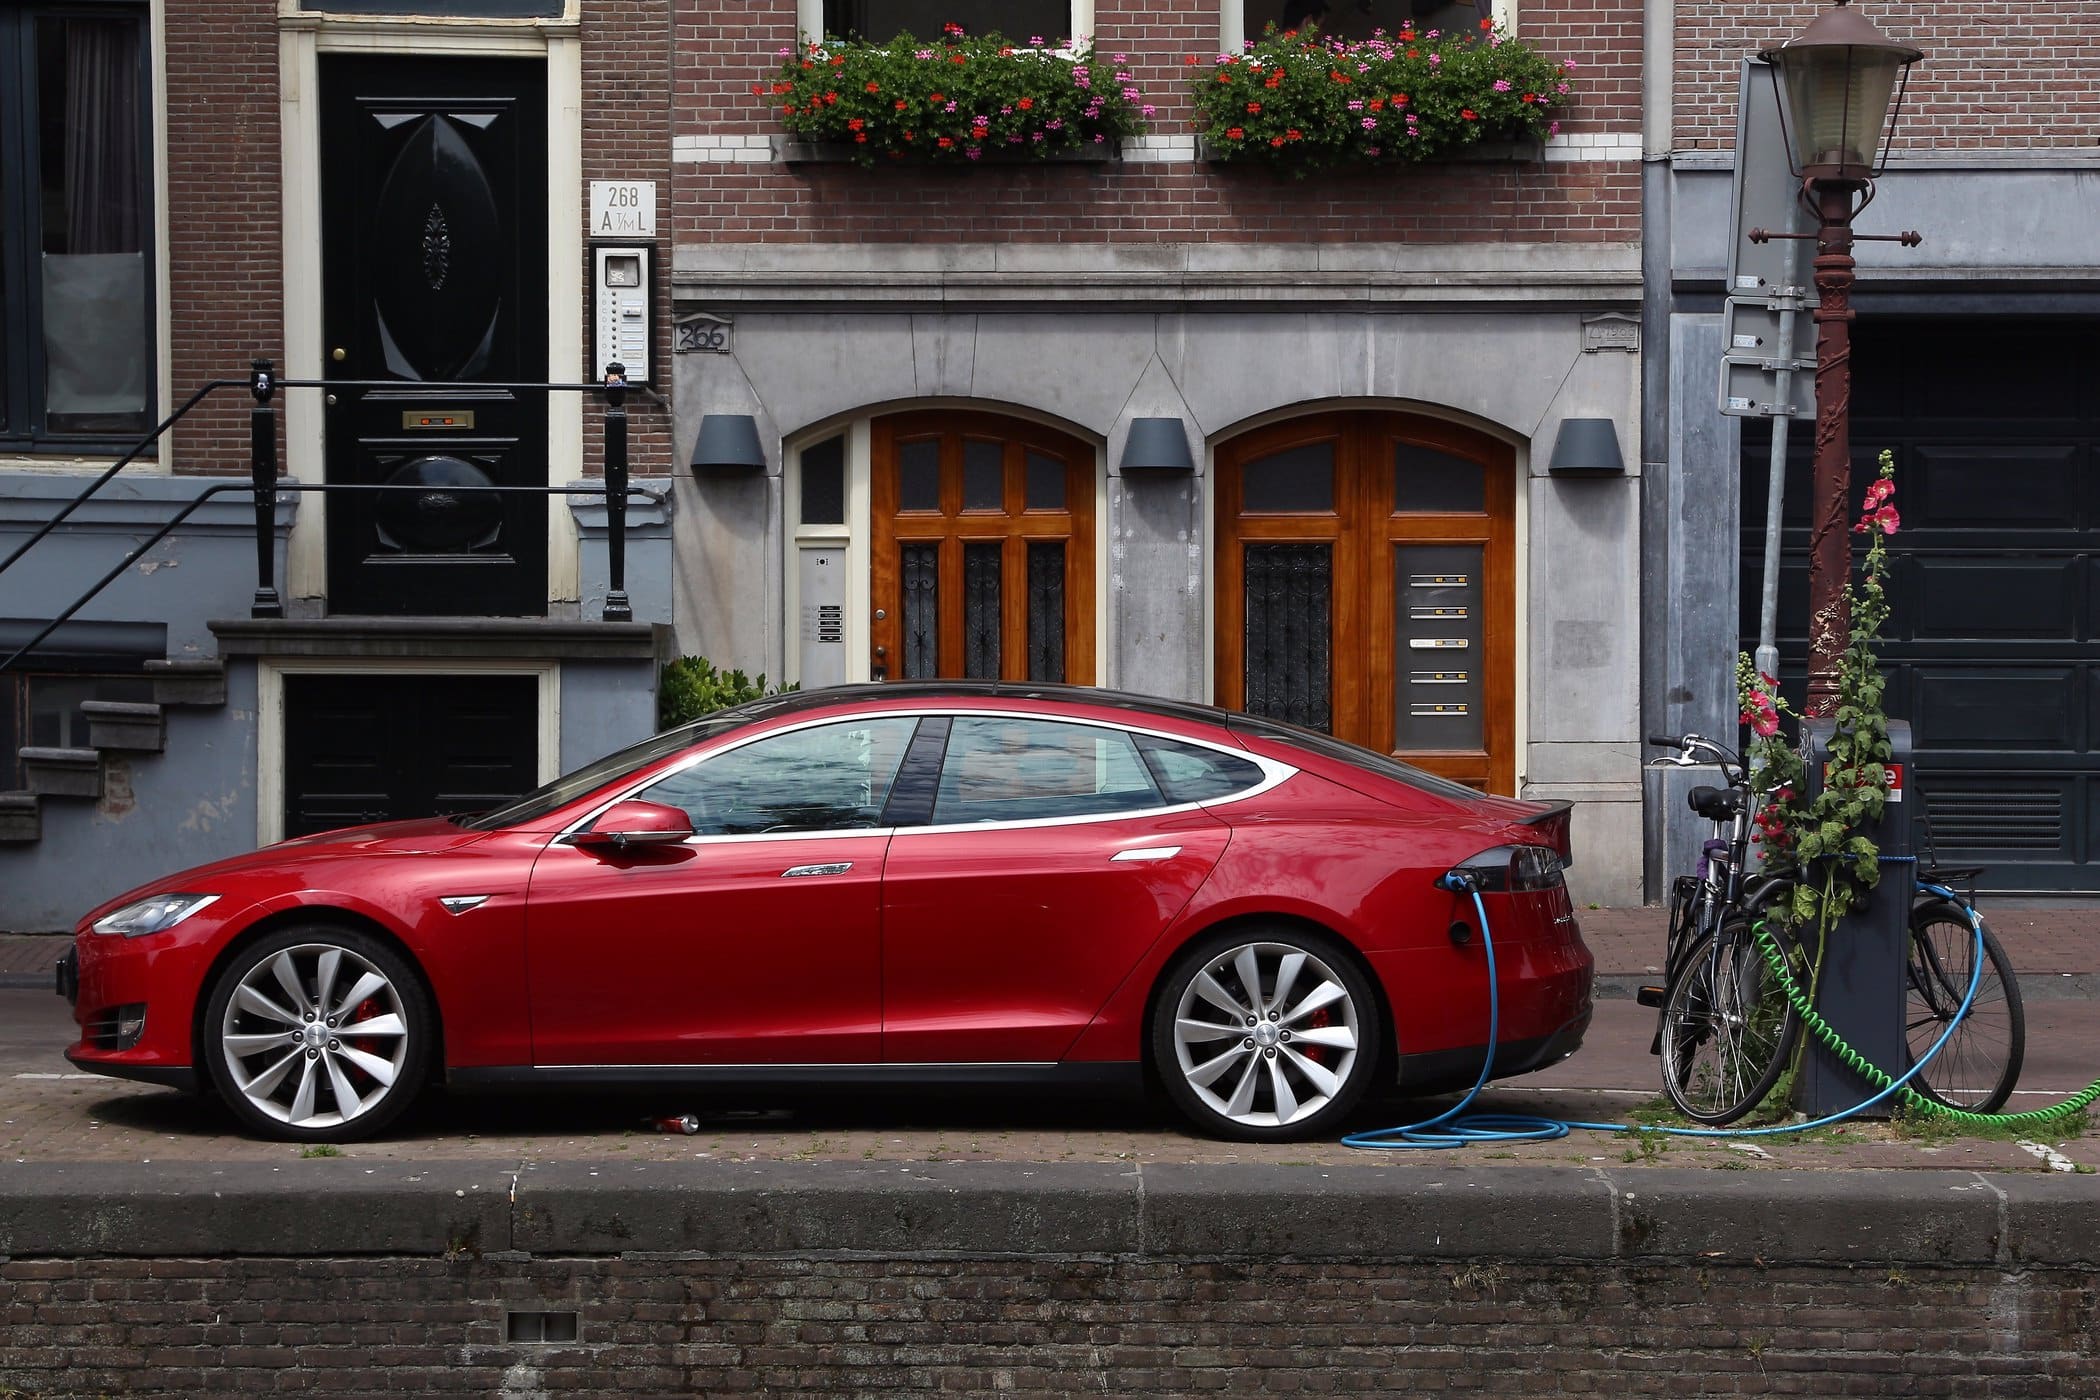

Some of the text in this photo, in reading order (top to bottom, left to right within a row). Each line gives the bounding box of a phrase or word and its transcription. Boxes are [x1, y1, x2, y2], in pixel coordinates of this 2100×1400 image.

[608, 187, 638, 207] 268
[601, 211, 612, 231] A
[638, 211, 647, 231] L
[680, 324, 725, 348] 266
